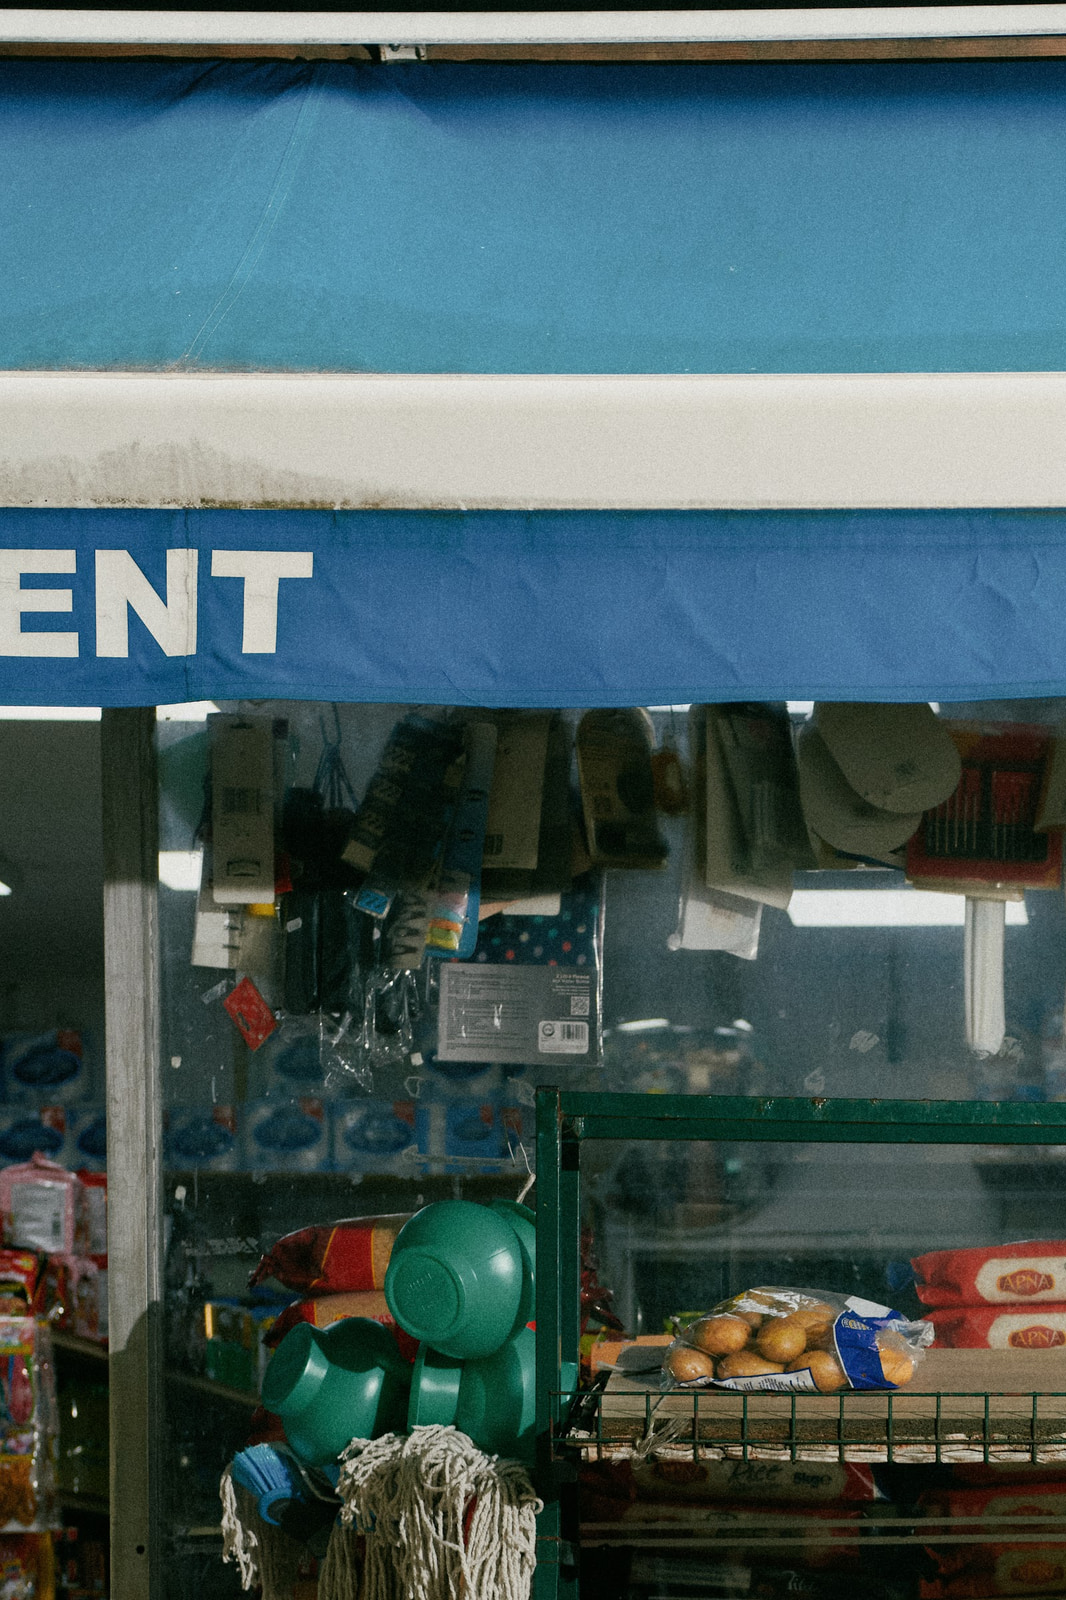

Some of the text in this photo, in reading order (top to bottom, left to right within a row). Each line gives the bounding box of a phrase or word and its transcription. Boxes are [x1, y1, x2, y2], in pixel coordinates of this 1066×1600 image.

[0, 548, 313, 658] ENT
[1003, 1273, 1053, 1291] APNA
[1014, 1329, 1065, 1346] APNA
